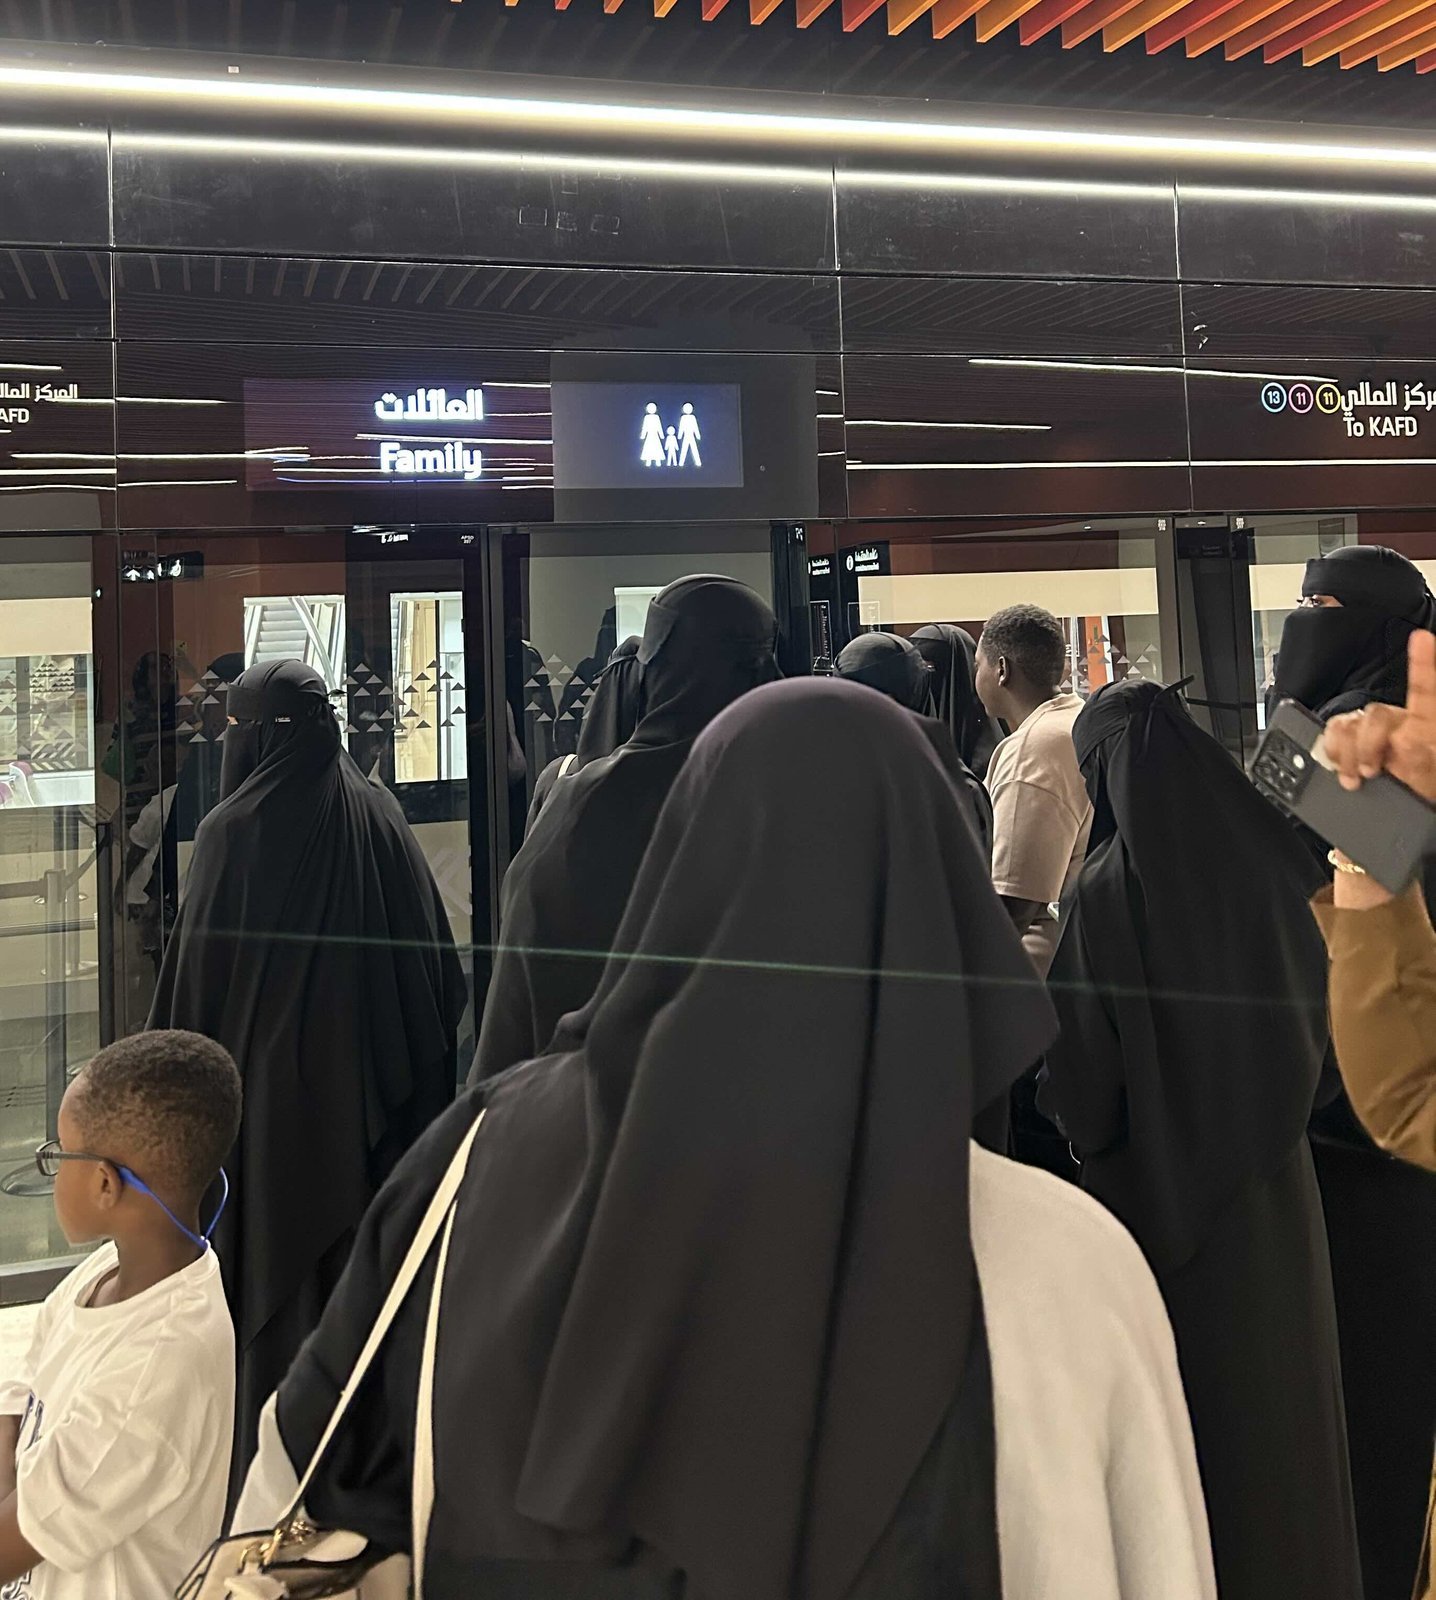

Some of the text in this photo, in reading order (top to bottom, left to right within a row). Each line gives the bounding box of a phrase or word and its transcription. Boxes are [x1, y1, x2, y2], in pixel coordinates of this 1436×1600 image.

[0, 382, 78, 402] المركز المال
[374, 387, 484, 420] العائلات
[1340, 381, 1436, 416] ركز المالي
[0, 407, 30, 424] AFD
[1343, 416, 1418, 437] To KAFD
[380, 441, 482, 480] Family
